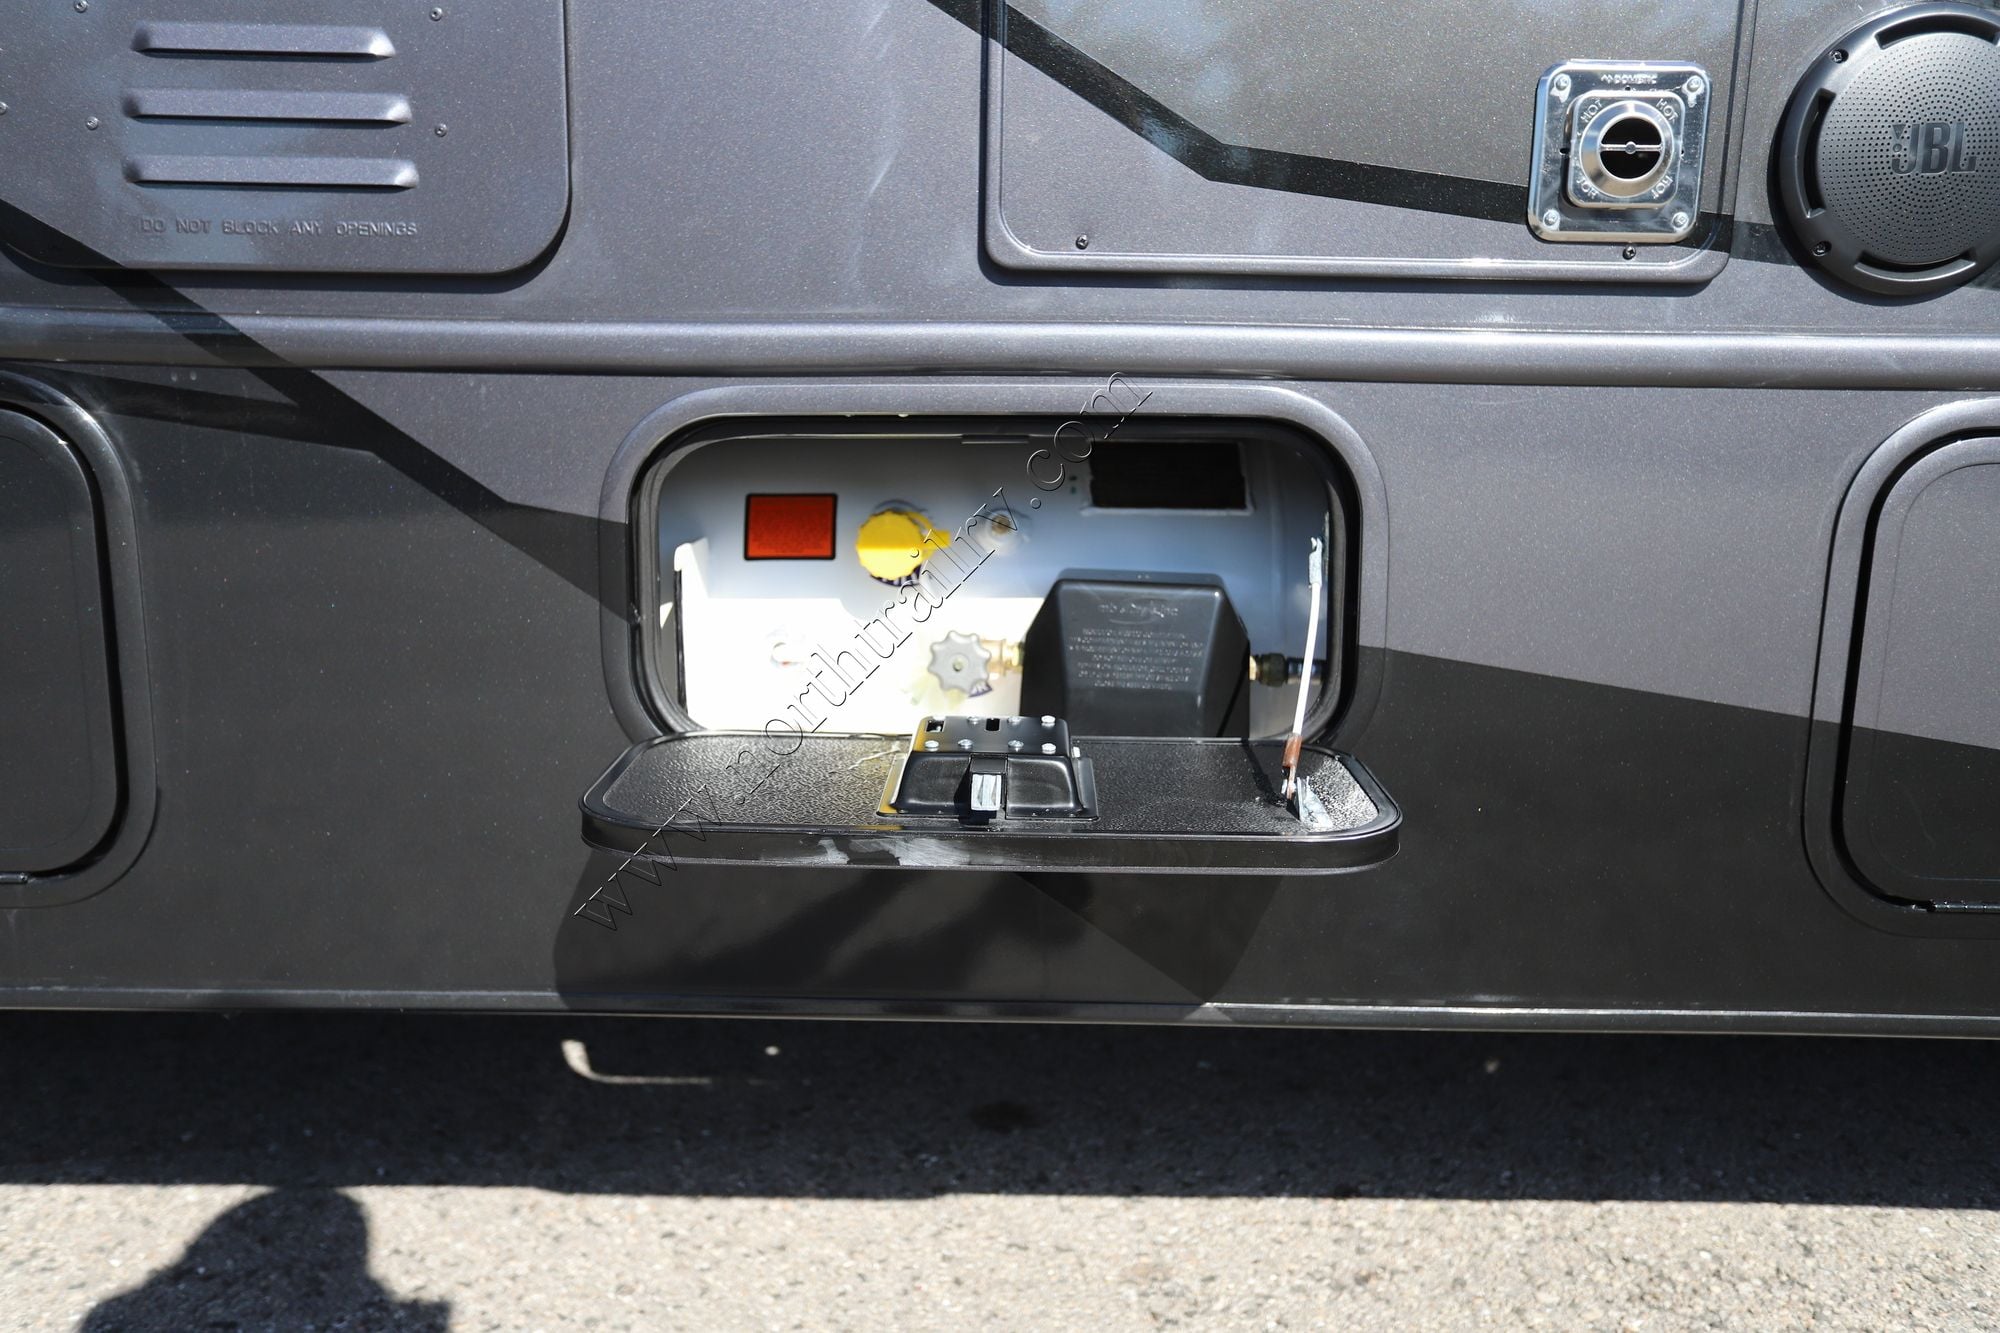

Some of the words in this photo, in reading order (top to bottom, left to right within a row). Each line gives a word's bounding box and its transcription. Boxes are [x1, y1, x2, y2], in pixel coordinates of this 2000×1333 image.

[1580, 99, 1604, 123] HOT
[1656, 98, 1679, 122] HOT
[1890, 121, 1977, 175] JBL
[141, 217, 166, 234] DO
[176, 218, 210, 234] NOT
[222, 219, 280, 235] BLOCK
[289, 220, 323, 236] ANY
[335, 221, 418, 236] OPENINGS
